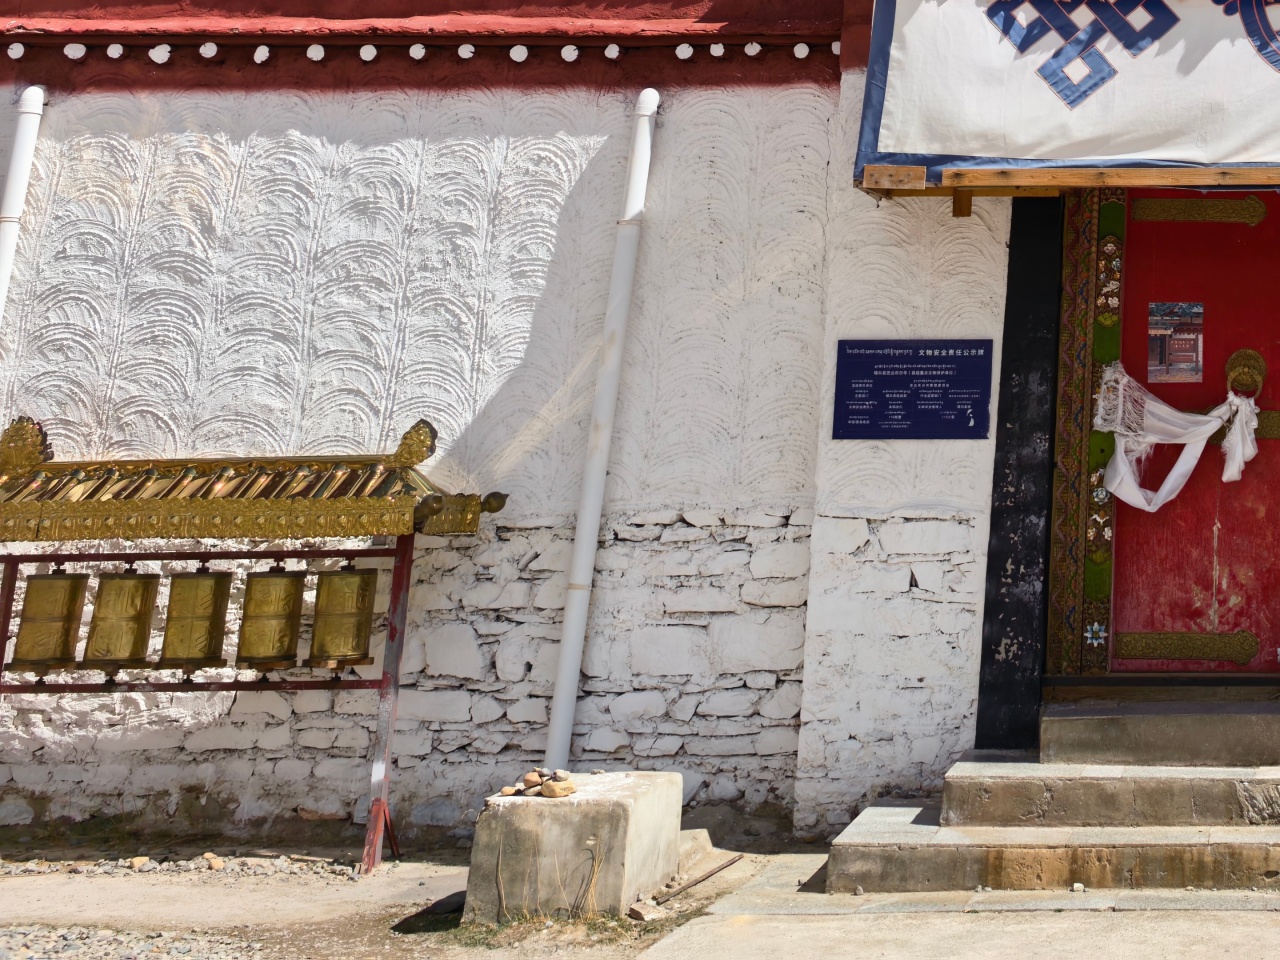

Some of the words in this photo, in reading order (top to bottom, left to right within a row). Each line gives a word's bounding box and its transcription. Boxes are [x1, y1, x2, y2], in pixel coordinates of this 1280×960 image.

[918, 348, 985, 356] 文物安全责任公示牌
